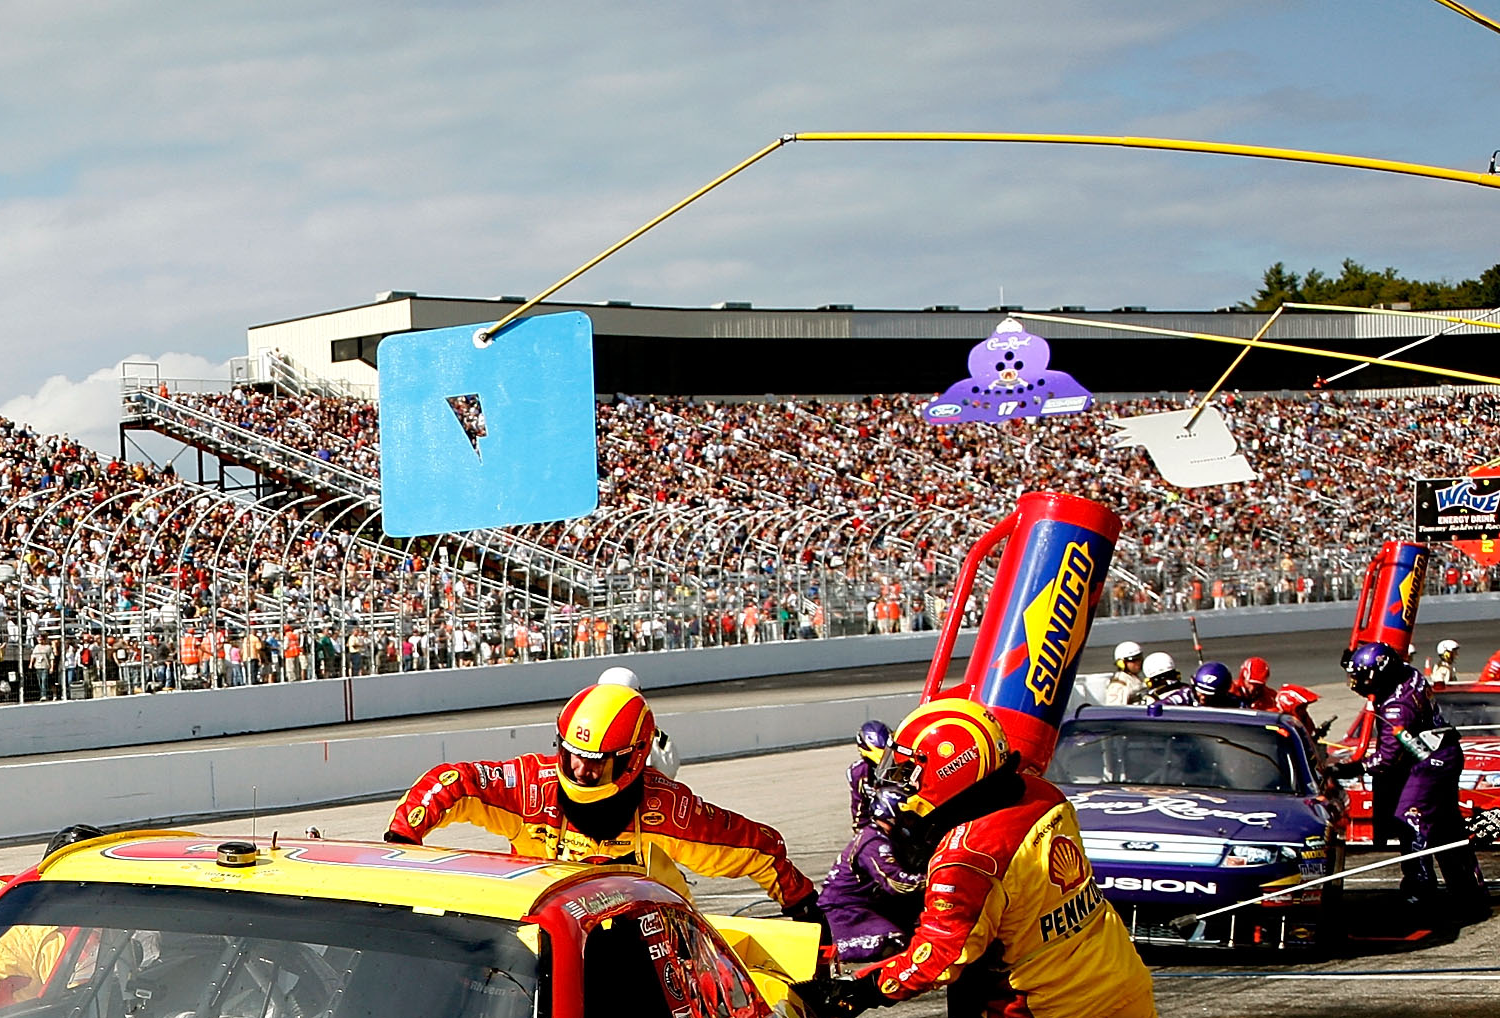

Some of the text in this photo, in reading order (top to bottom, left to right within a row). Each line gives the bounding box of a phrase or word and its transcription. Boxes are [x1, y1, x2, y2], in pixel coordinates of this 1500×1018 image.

[998, 402, 1018, 415] 17
[1435, 480, 1500, 513] WAVE
[1438, 514, 1496, 525] ENERGY DRINK
[1419, 525, 1446, 533] Tommy
[1404, 557, 1426, 625] SUNOCO
[1031, 546, 1092, 703] SUNOCO
[576, 727, 590, 742] 29
